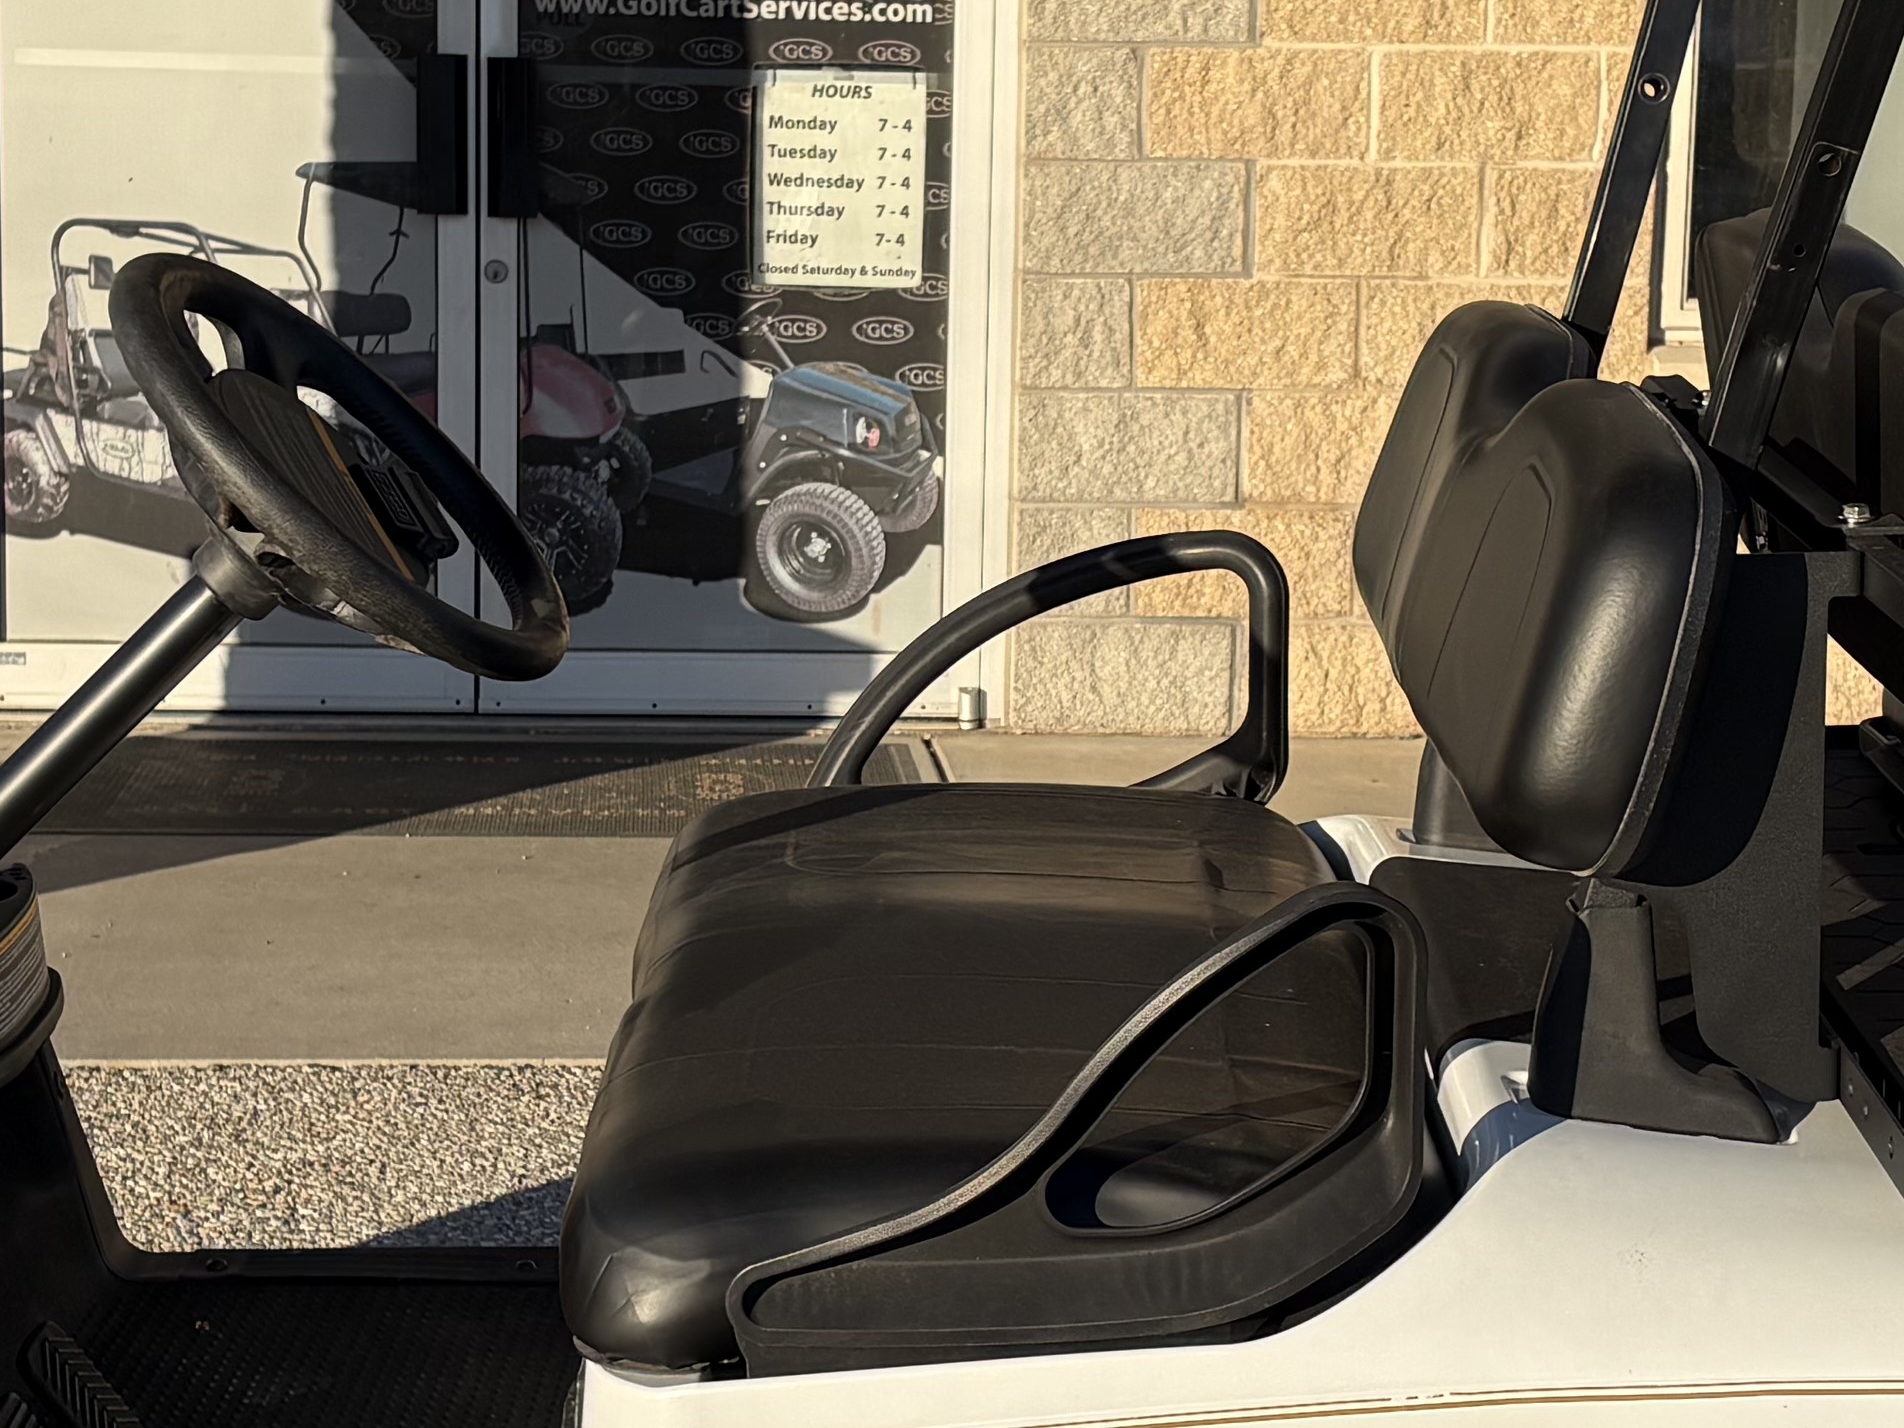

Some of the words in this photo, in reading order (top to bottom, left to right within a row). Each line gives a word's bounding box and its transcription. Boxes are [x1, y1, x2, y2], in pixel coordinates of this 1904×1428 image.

[811, 83, 873, 100] HOURS
[768, 115, 837, 135] Monday
[878, 118, 889, 133] 7
[902, 119, 913, 133] 4
[767, 144, 837, 163] Tuesday
[877, 147, 888, 161] 7
[902, 148, 912, 162] 4
[767, 172, 865, 193] Wednesday
[876, 175, 887, 190] 7
[900, 176, 911, 191] 4
[766, 201, 845, 220] Thursday
[875, 204, 886, 219] 7
[899, 205, 910, 219] 4
[766, 230, 819, 248] Friday
[757, 262, 798, 276] Closed
[802, 264, 856, 279] Saturday
[860, 266, 869, 276] &
[871, 266, 918, 279] Sunday
